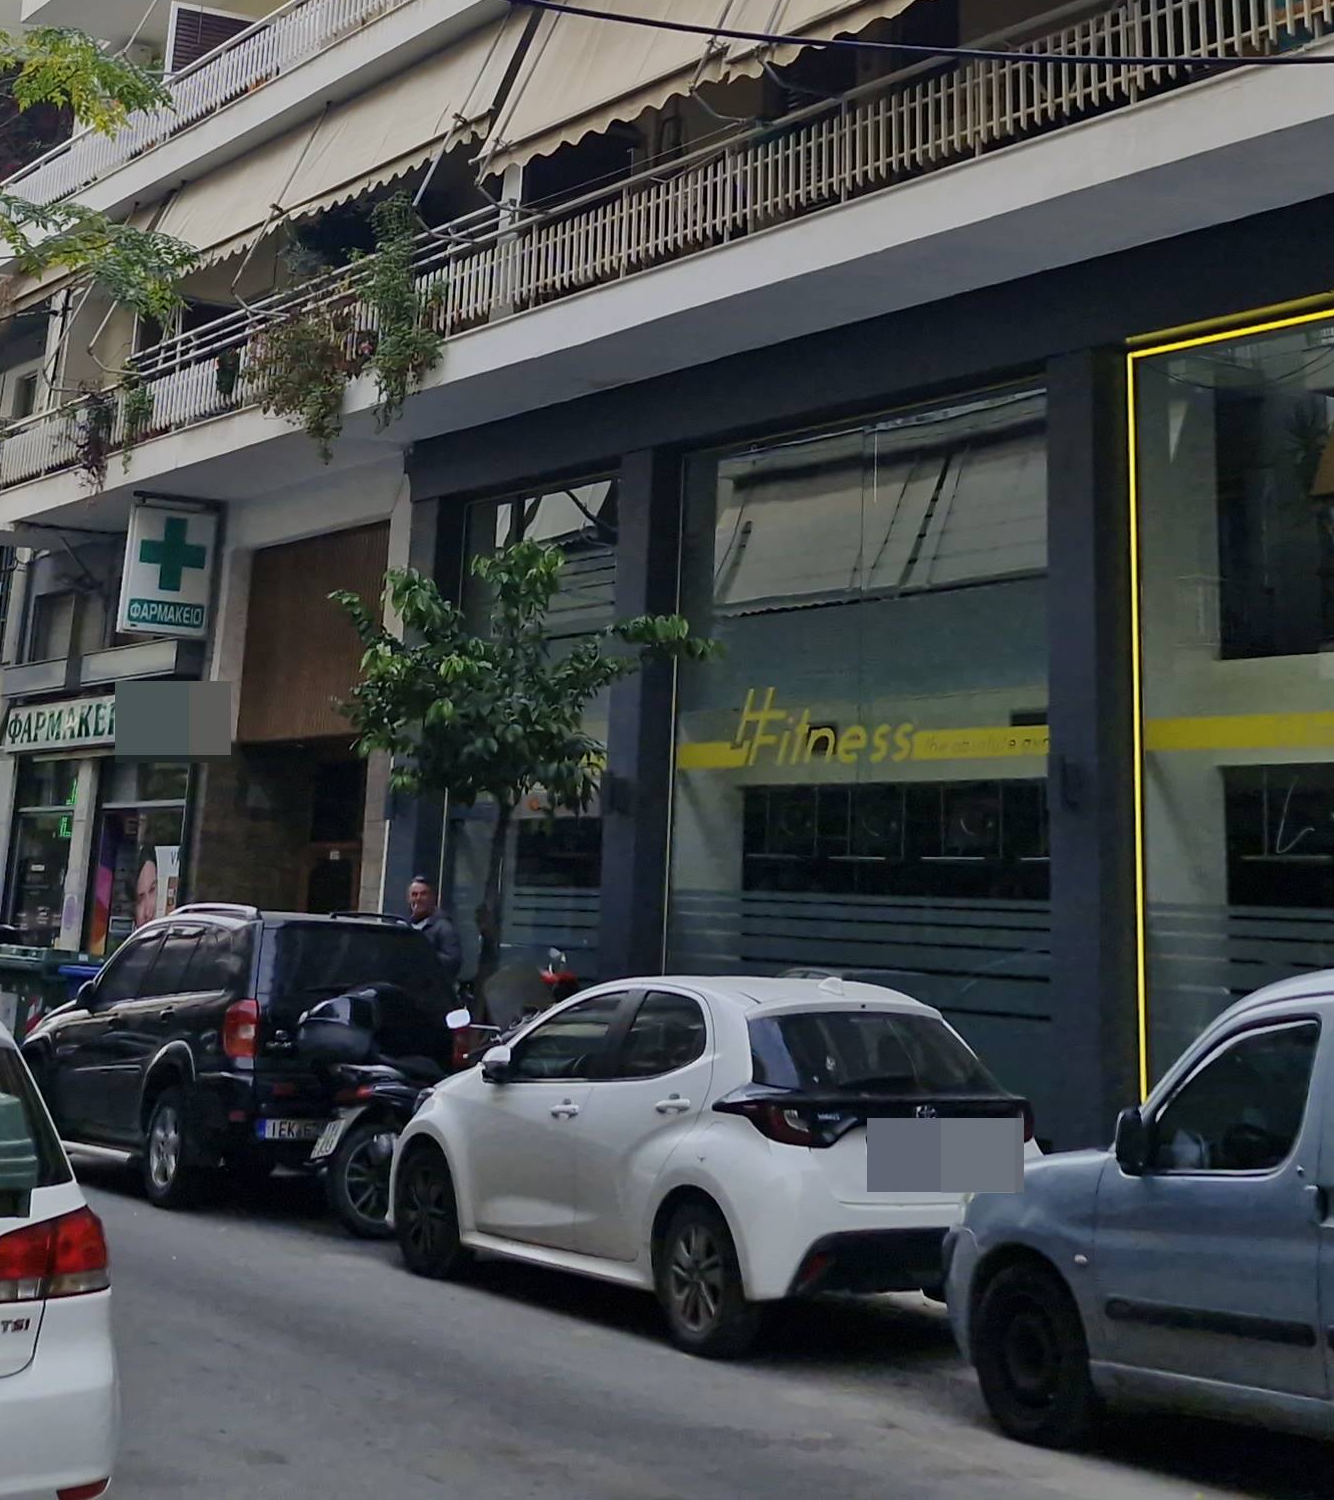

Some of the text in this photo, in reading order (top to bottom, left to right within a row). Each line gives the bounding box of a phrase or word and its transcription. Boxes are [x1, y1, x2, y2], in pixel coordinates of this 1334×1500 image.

[129, 603, 202, 625] ΦΑΡΜΑΚΕΙΟ
[8, 703, 115, 745] ΦΑΡΜΑΚΕΙ
[0, 1318, 30, 1334] TSI
